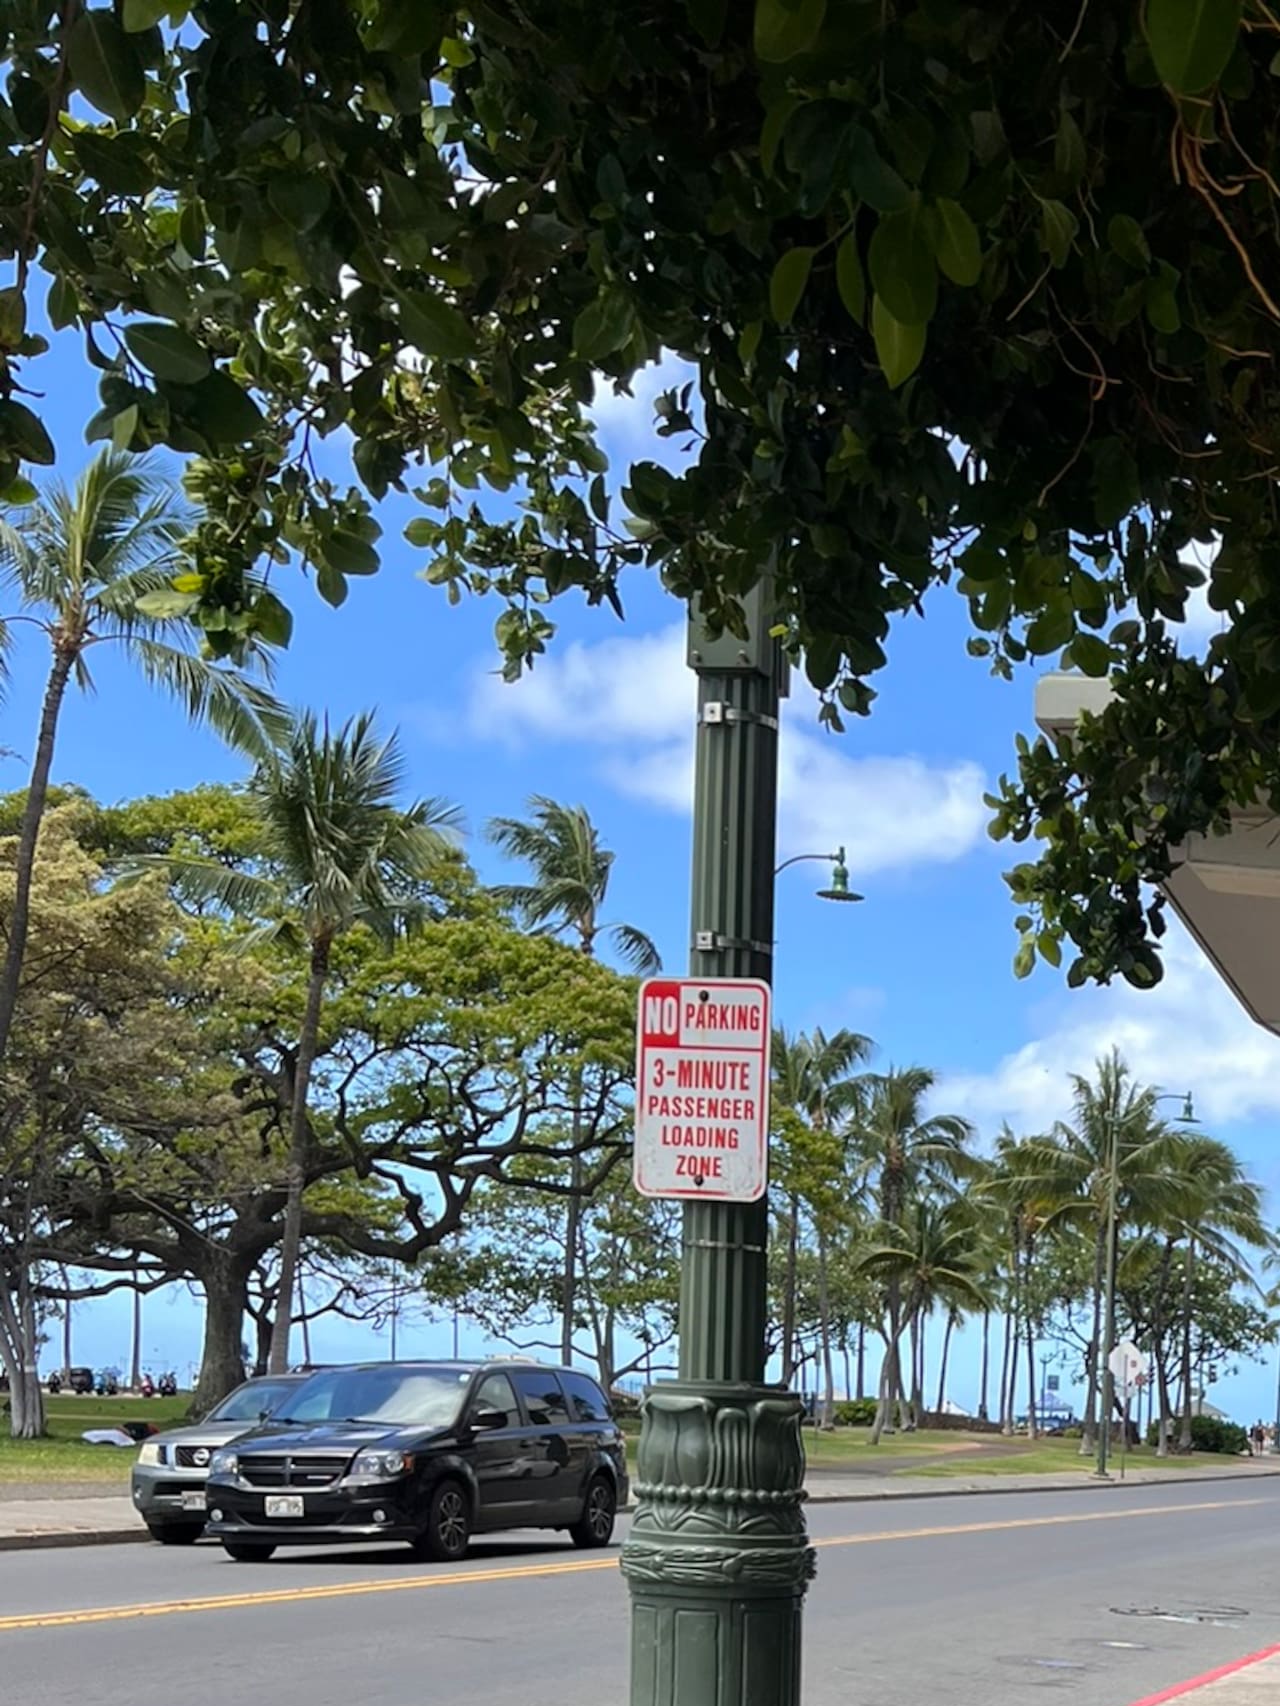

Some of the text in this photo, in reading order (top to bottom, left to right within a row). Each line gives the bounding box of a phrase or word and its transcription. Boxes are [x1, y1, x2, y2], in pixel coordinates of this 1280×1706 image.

[645, 996, 760, 1035] NO PARKING
[653, 1058, 750, 1091] 3-MINUTE
[648, 1096, 755, 1120] PASSENGER
[662, 1125, 739, 1149] LOADING
[676, 1155, 722, 1177] ZONE
